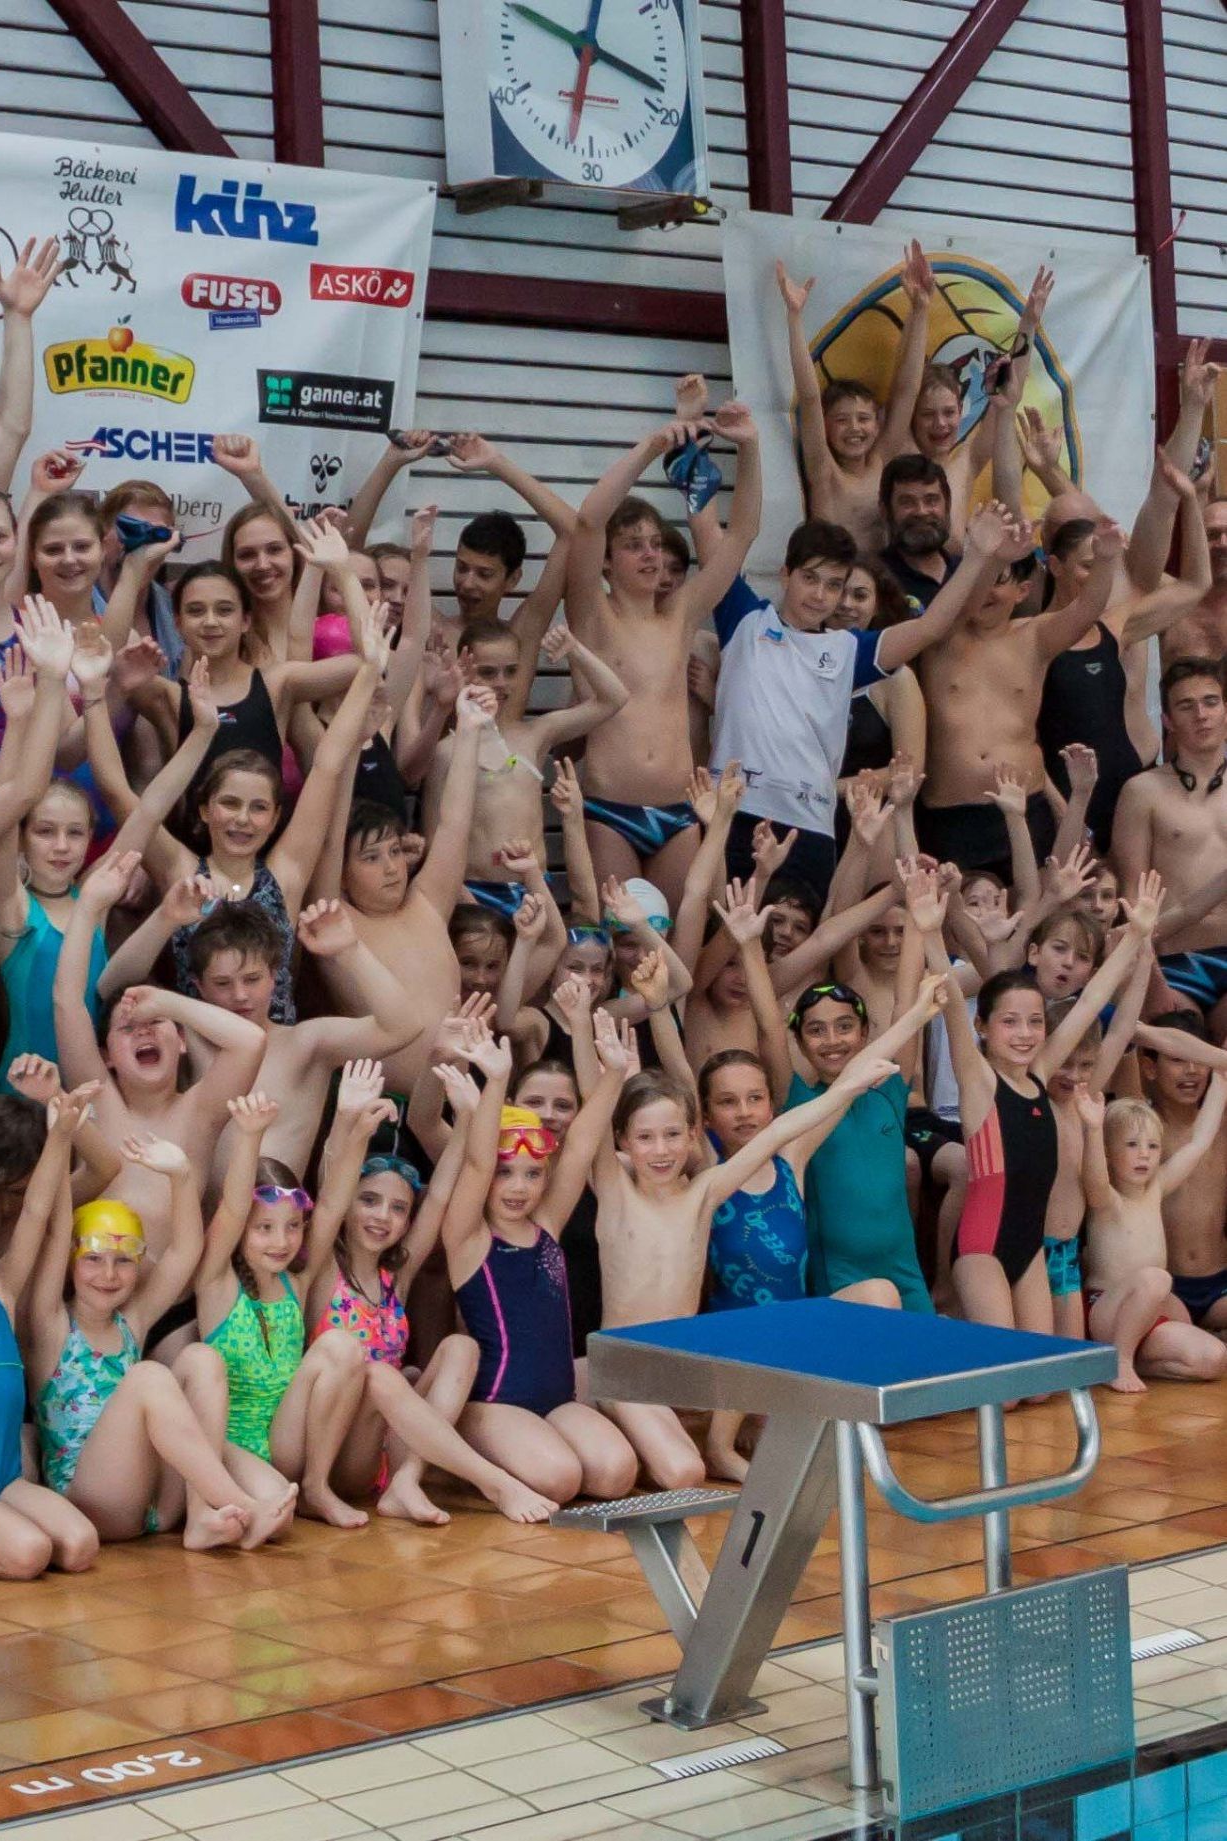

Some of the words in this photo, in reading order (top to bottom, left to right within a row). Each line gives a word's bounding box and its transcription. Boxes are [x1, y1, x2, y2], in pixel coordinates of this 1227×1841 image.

[493, 86, 516, 105] 40
[660, 108, 680, 127] 20
[53, 156, 138, 185] Bäckerei
[581, 163, 603, 182] 30
[59, 181, 122, 206] Hutter
[191, 279, 275, 311] FUSSL
[318, 270, 381, 298] ASKÖ
[300, 385, 383, 409] ganner.at
[740, 1510, 765, 1568] 1
[10, 1776, 74, 1794] m
